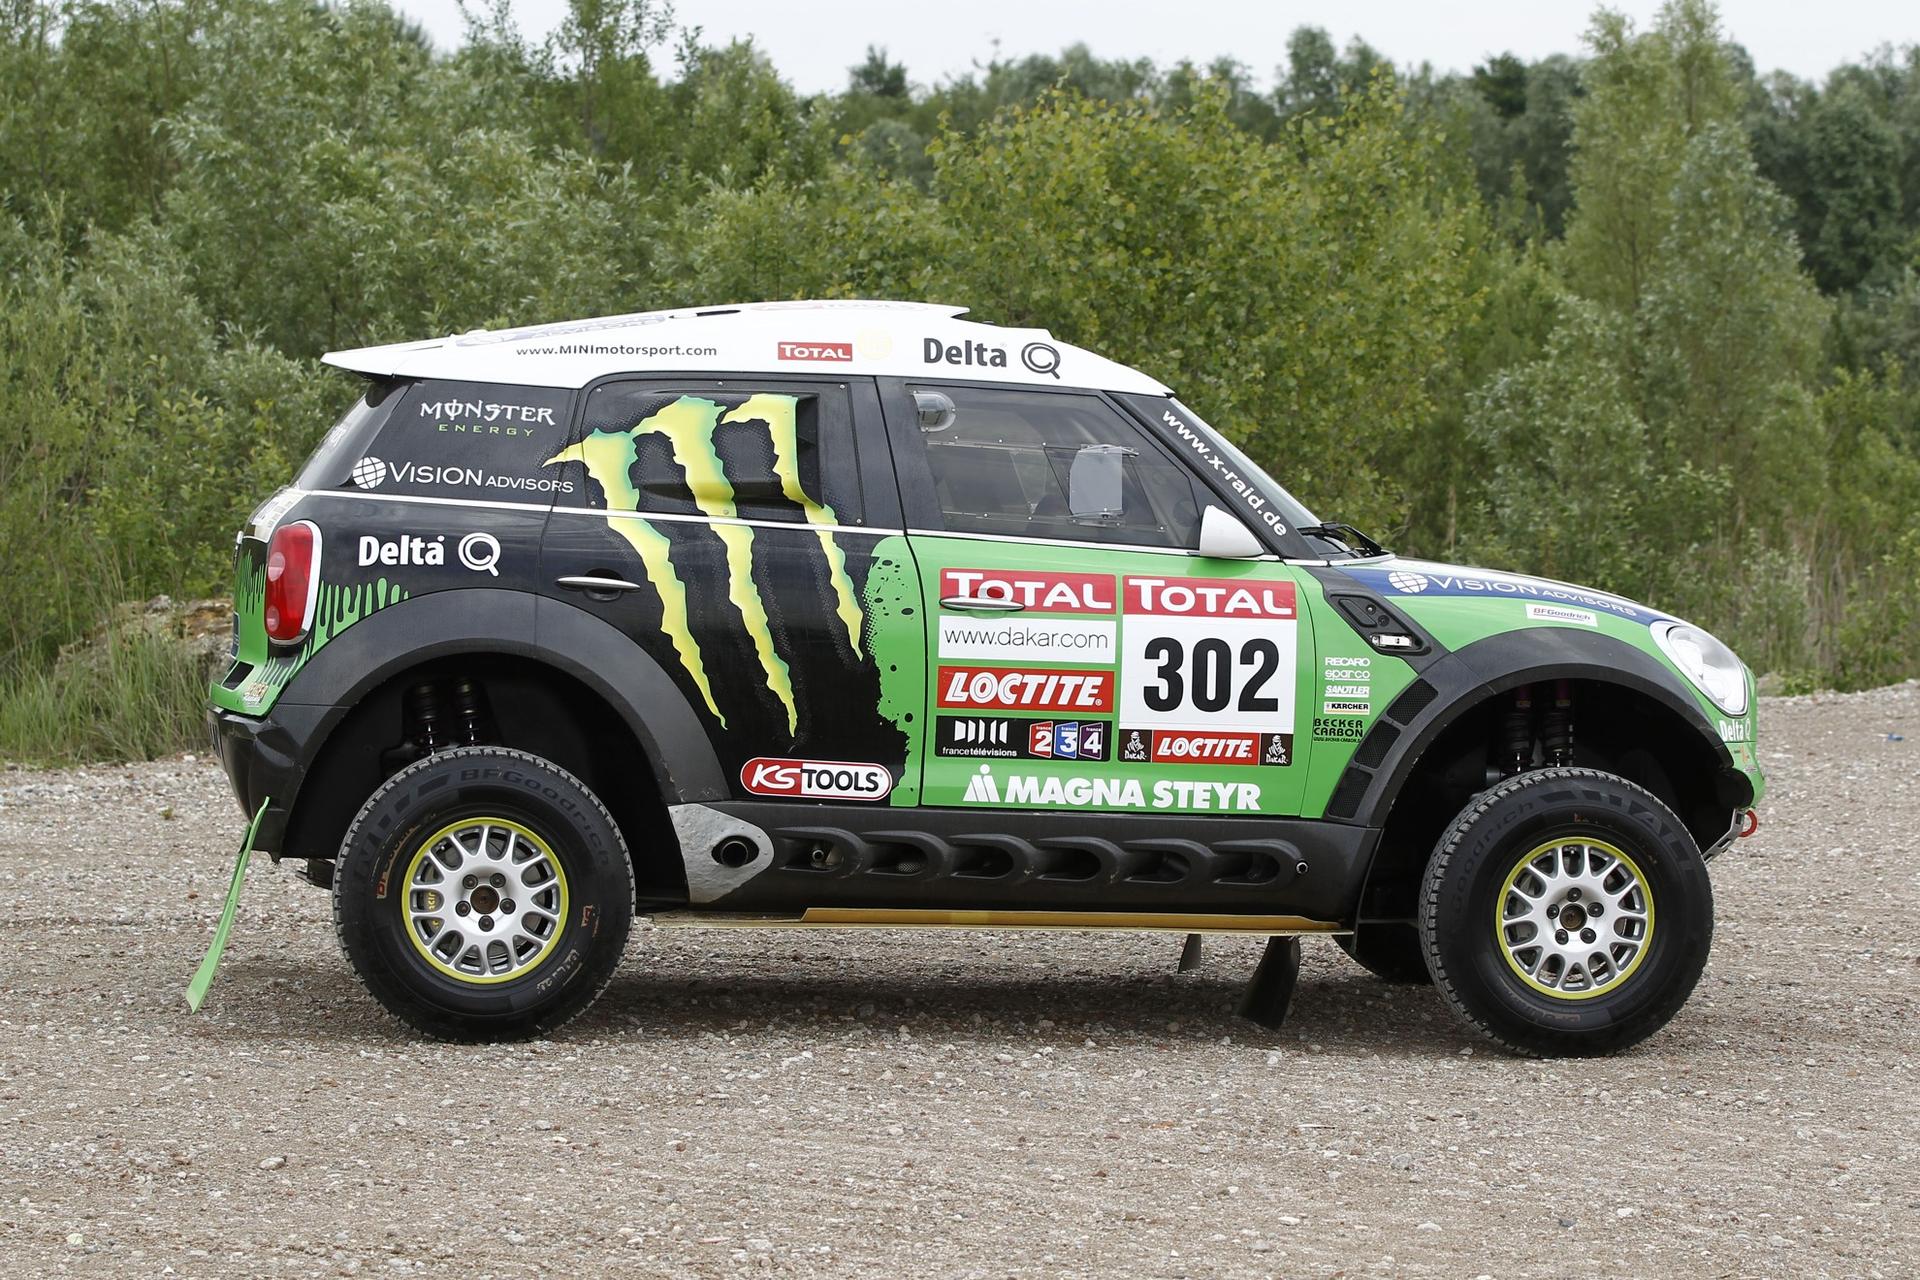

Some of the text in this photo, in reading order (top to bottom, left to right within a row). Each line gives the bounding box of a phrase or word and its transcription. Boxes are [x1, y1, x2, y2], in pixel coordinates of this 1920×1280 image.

[516, 344, 717, 357] www.MINImotorsport.com
[780, 344, 851, 359] TOTAL
[923, 337, 1007, 367] Delta
[420, 399, 555, 426] MONSTER
[439, 423, 534, 437] ENERGY
[389, 461, 574, 493] VISION ADVISORS
[1162, 410, 1287, 536] www.x-raid.de
[358, 534, 445, 567] Delta
[946, 572, 1112, 609] TOTAL
[1128, 578, 1294, 615] TOTAL
[1427, 575, 1637, 617] VISION ADVISORS
[1533, 607, 1591, 621] BFGoodrich
[944, 626, 1108, 649] www.dakar.com
[1325, 657, 1370, 666] RECARO
[1143, 637, 1280, 713] 302
[1325, 669, 1370, 681] sparco
[1313, 718, 1363, 729] BECKER
[1313, 728, 1363, 737] CARBON
[1718, 719, 1744, 742] Delta
[1034, 731, 1052, 752] 2
[1060, 731, 1077, 753] 3
[1083, 732, 1102, 754] 4
[751, 763, 879, 792] KS TOOLS
[1004, 775, 1262, 811] MAGNA STEYR
